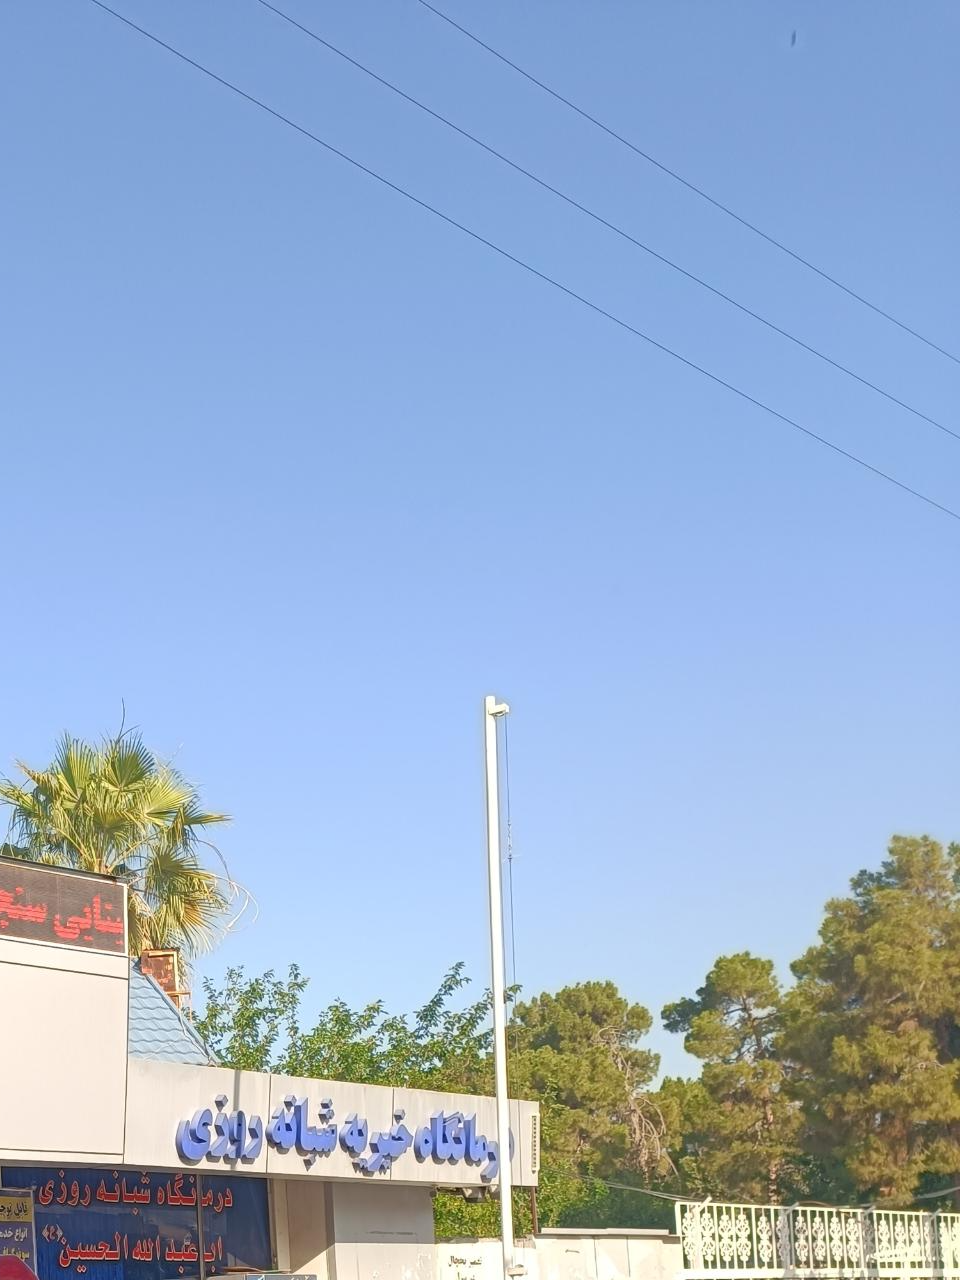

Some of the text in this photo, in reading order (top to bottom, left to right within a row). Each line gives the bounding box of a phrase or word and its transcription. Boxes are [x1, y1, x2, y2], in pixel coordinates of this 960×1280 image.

[175, 1094, 516, 1183] رمانگاه خیریه شبانه روزی
[39, 1169, 233, 1216] درمنگاه شبانه روزی
[14, 1227, 28, 1242] انواع
